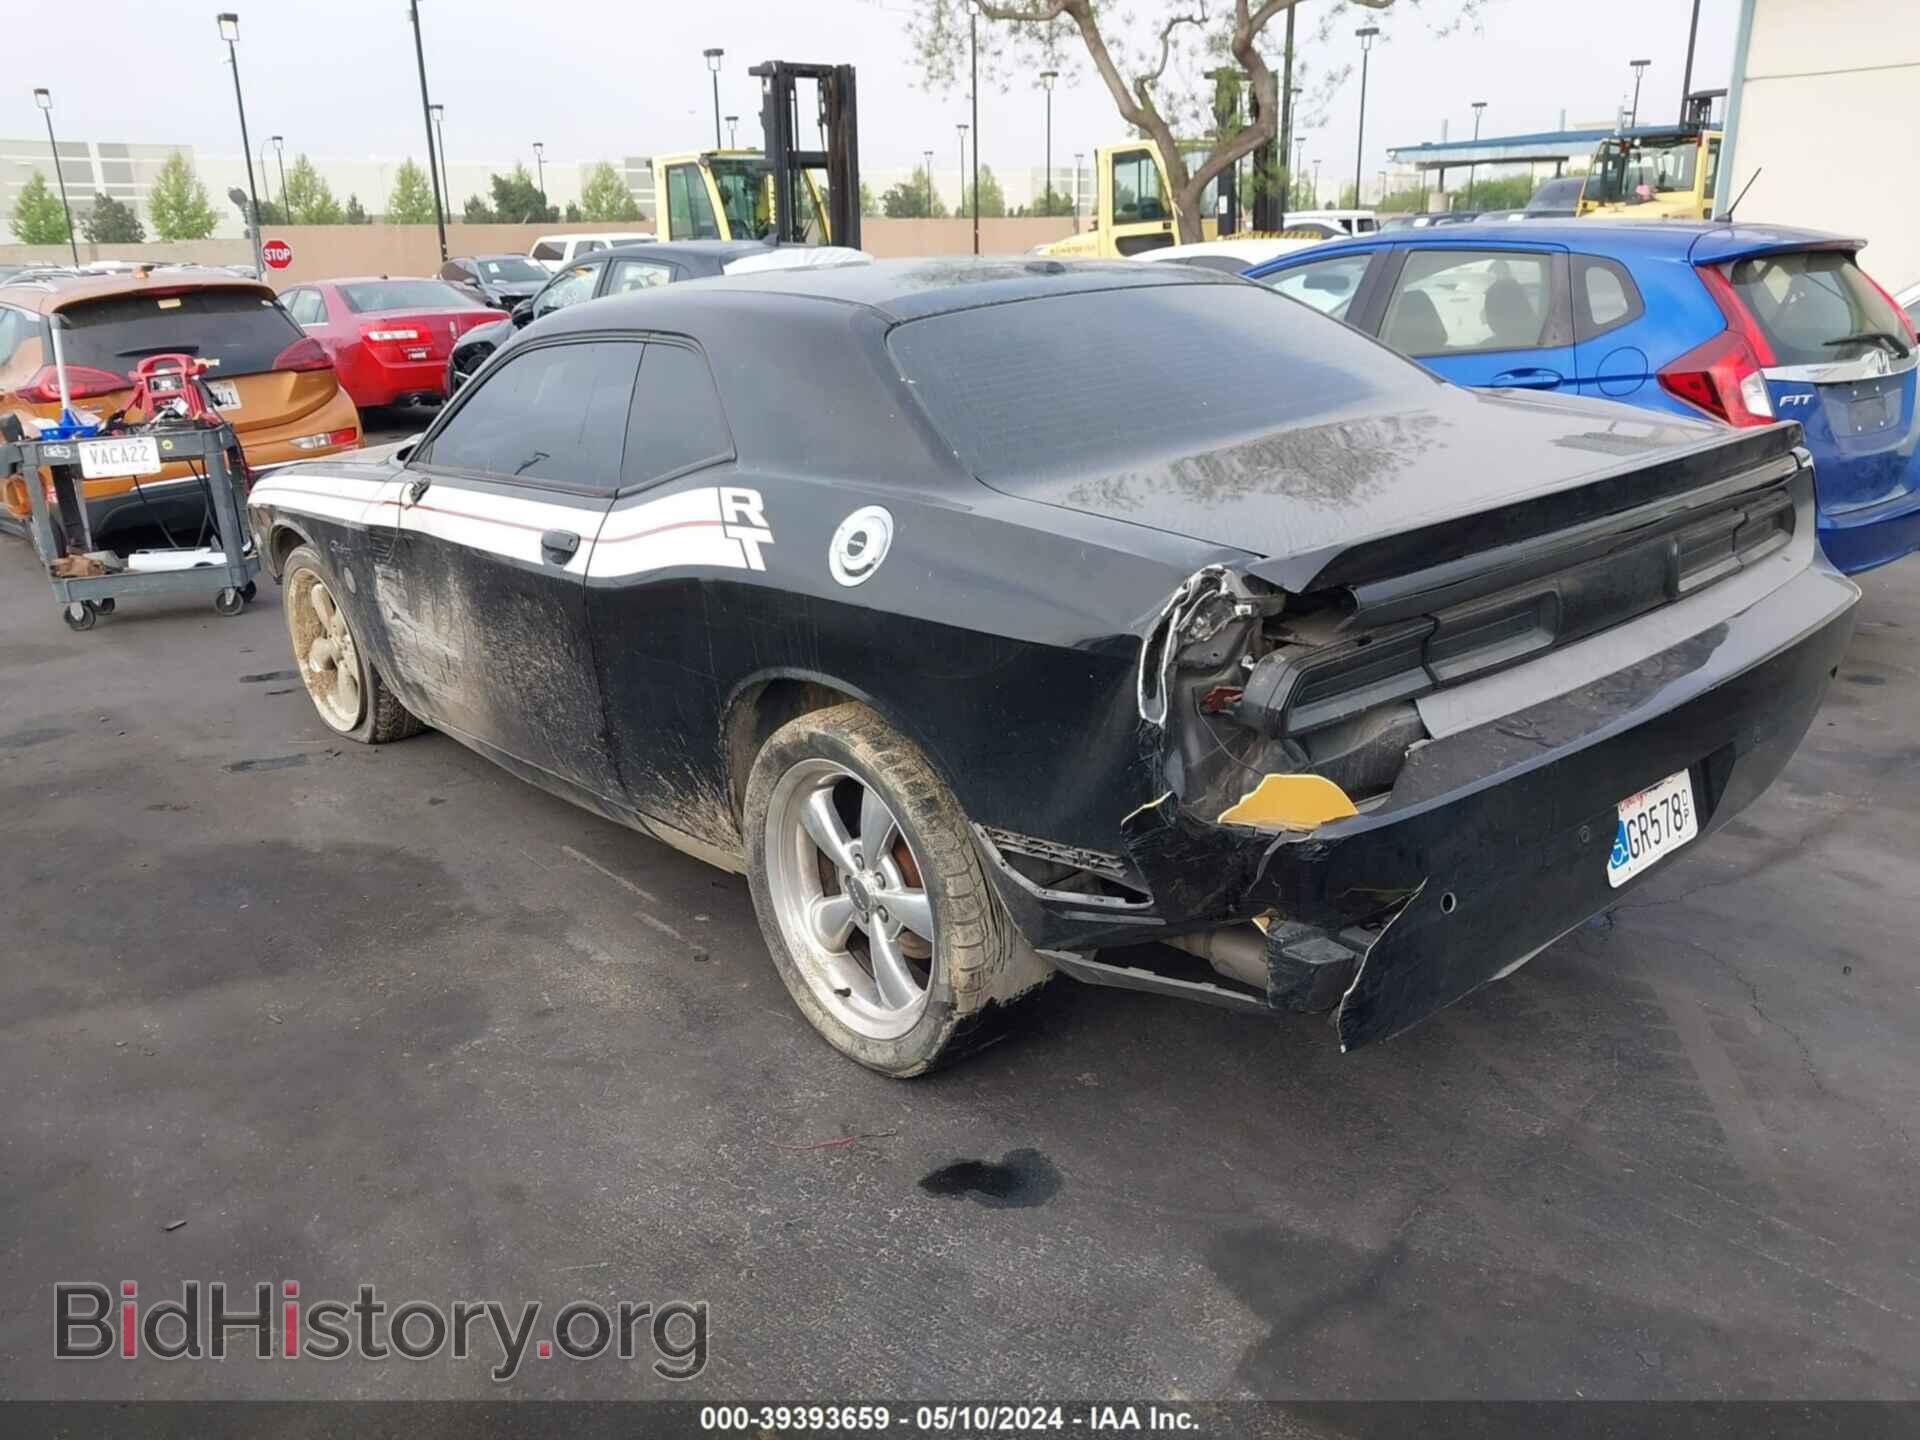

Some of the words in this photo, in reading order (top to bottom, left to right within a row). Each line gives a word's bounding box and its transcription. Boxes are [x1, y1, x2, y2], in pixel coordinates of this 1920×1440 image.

[264, 248, 290, 261] STOP
[1779, 394, 1814, 408] FIT
[89, 445, 150, 465] VACA22
[1627, 793, 1683, 859] GR578
